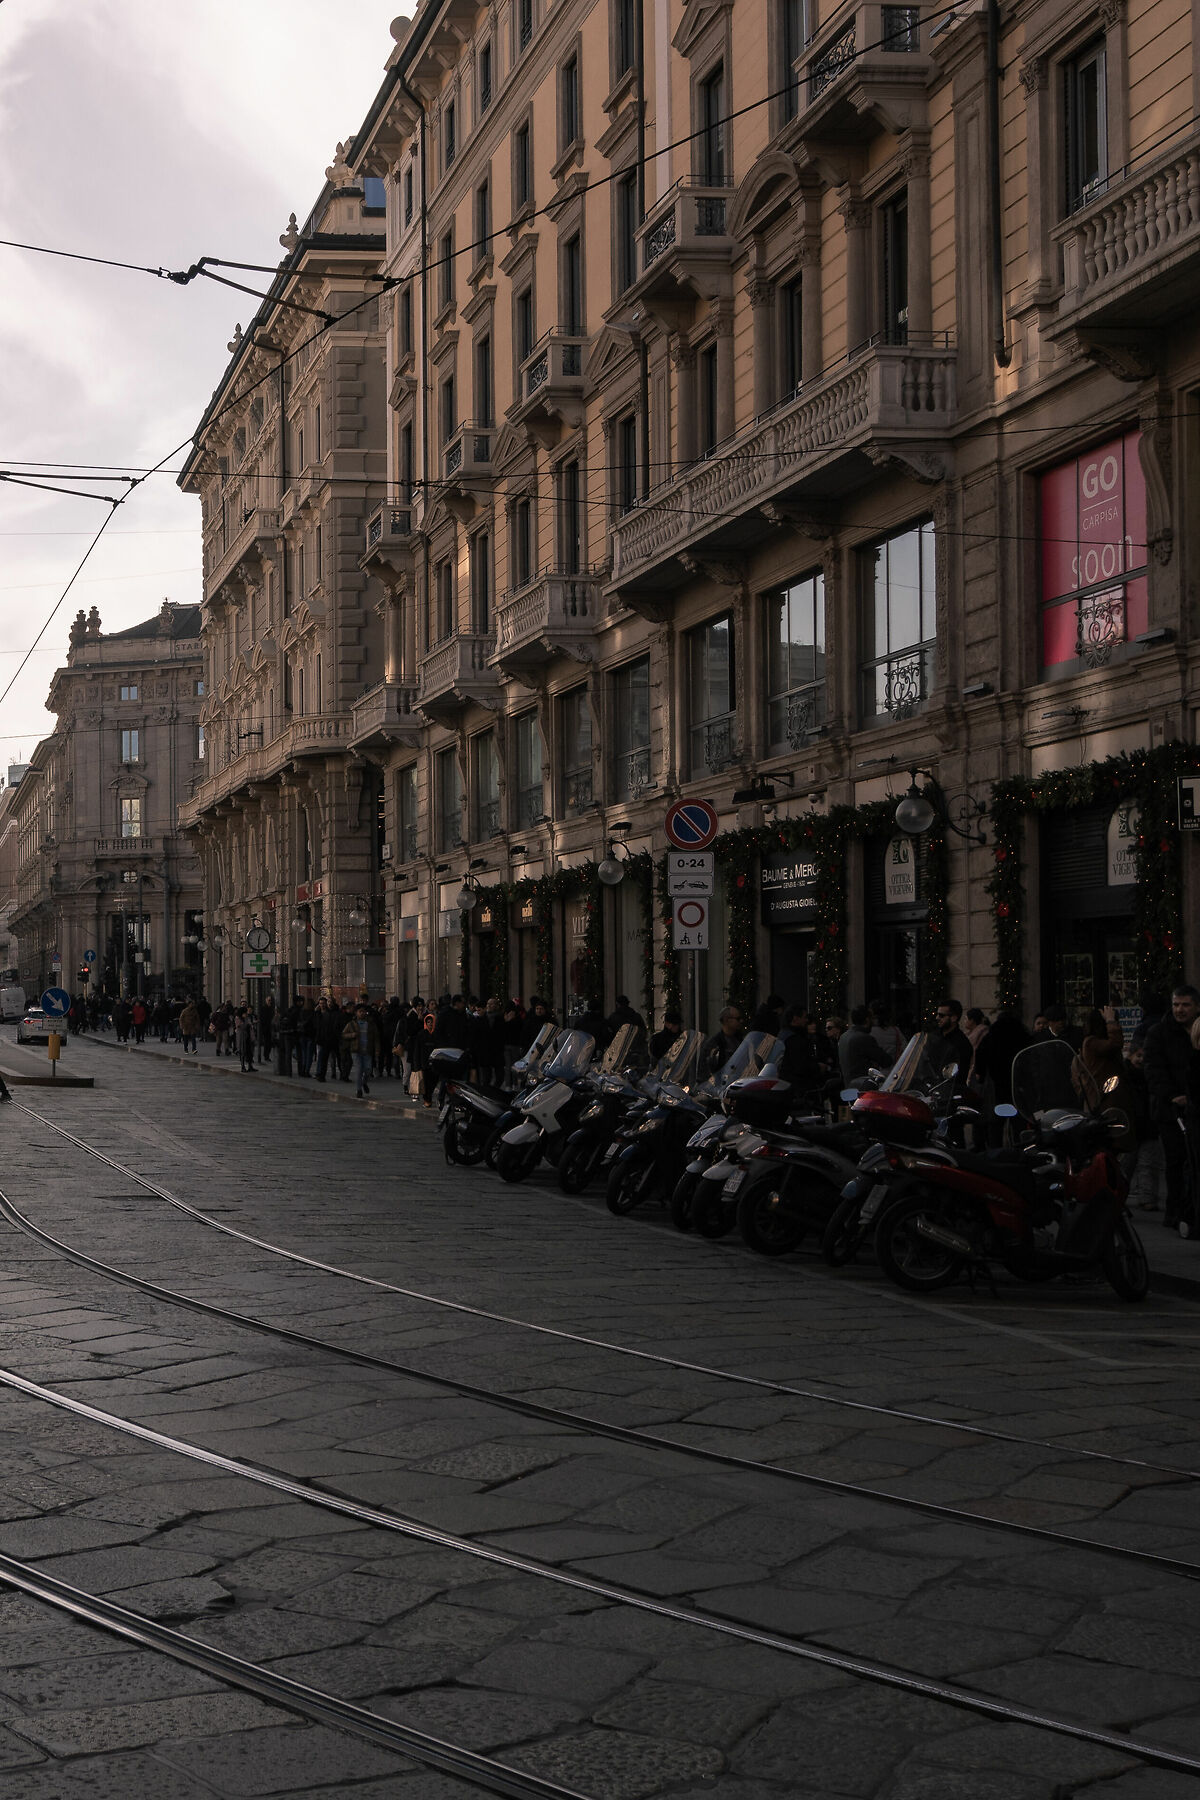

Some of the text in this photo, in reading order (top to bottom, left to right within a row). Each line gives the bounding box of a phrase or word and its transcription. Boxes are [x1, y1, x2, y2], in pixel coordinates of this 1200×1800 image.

[1082, 455, 1118, 499] GO
[1082, 506, 1119, 532] CARPISA
[1071, 535, 1133, 589] soon
[677, 858, 705, 867] 0-24
[763, 867, 788, 883] BAUME
[795, 863, 819, 878] MERC
